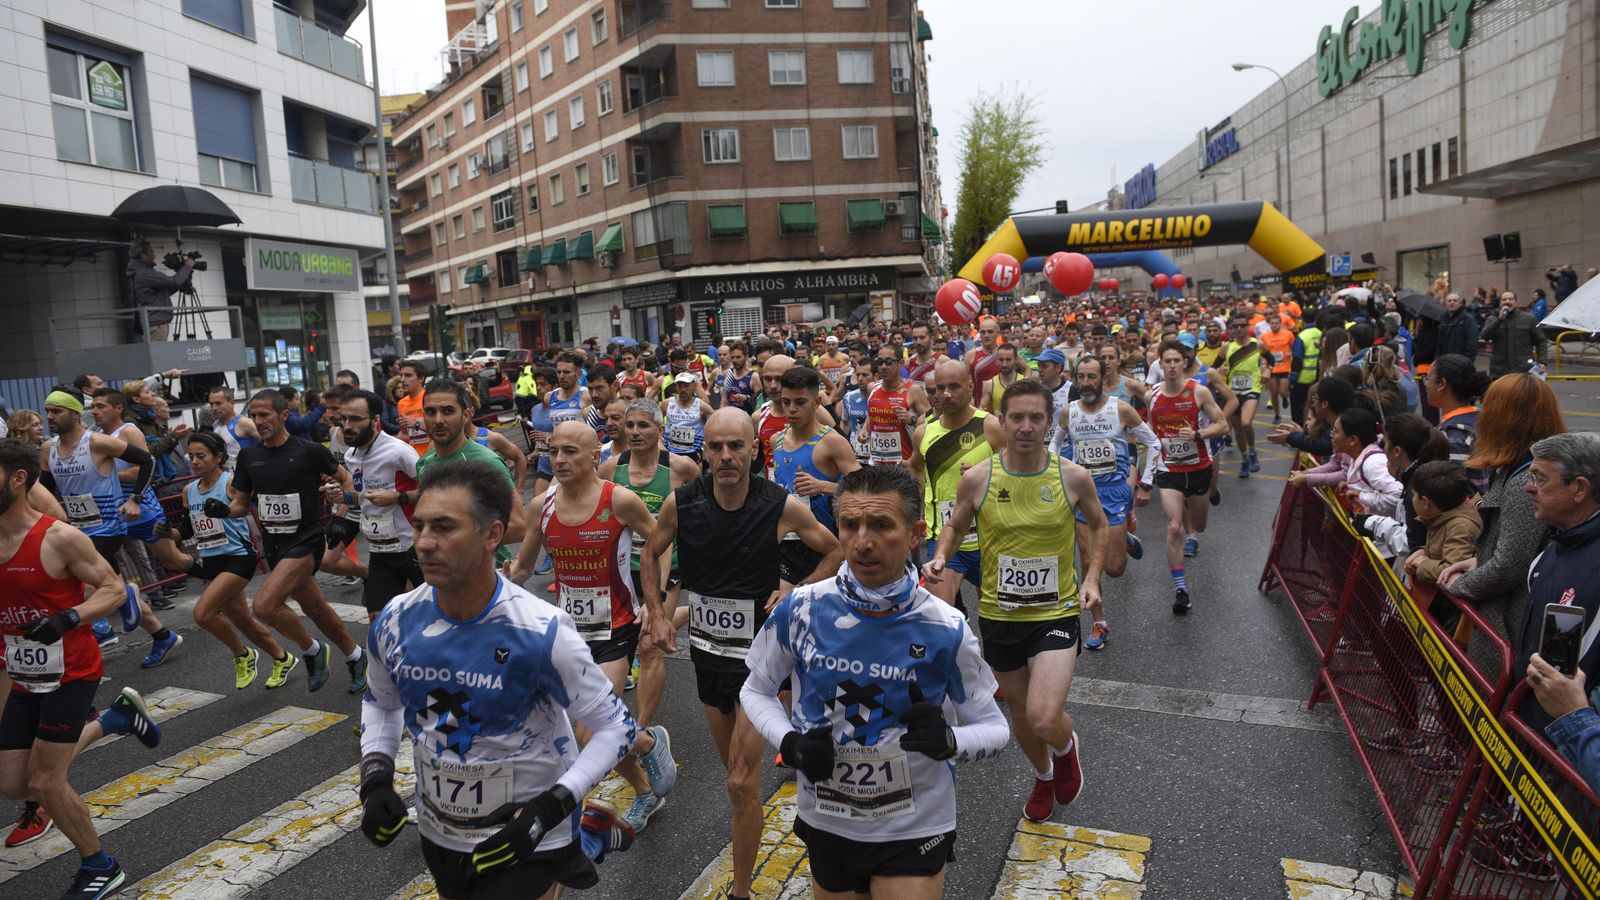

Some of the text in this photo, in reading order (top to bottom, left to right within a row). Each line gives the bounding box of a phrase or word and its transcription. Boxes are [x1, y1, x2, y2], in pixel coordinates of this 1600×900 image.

[1066, 214, 1212, 246] MARCELINO
[703, 272, 880, 295] ARMARIOS ALHAMBRA
[671, 430, 692, 440] 3211
[1075, 423, 1113, 434] MARACENA
[873, 438, 898, 449] 1568
[1169, 442, 1190, 454] 626
[1080, 446, 1111, 459] 1386
[69, 502, 88, 513] 521
[265, 503, 291, 515] 798
[194, 518, 214, 532] 660
[371, 522, 380, 534] 2
[1017, 558, 1043, 566] OXIMESA
[1004, 567, 1051, 588] 2807
[565, 597, 595, 616] 851
[708, 598, 737, 606] OXIMESA
[695, 606, 746, 630] 1069
[711, 628, 730, 636] JESUS
[14, 647, 49, 666] 450
[815, 656, 918, 683] TODO SUMA
[401, 664, 504, 691] TODO SUMA
[1445, 670, 1476, 717] MARCELINO
[1476, 716, 1513, 771] MARCELINO
[442, 761, 485, 774] OXIMESA
[836, 761, 894, 786] 221
[432, 774, 483, 805] 171
[861, 785, 889, 795] MIGUEL
[440, 802, 479, 815] VICTOR M
[1517, 773, 1564, 840] MARCELINO
